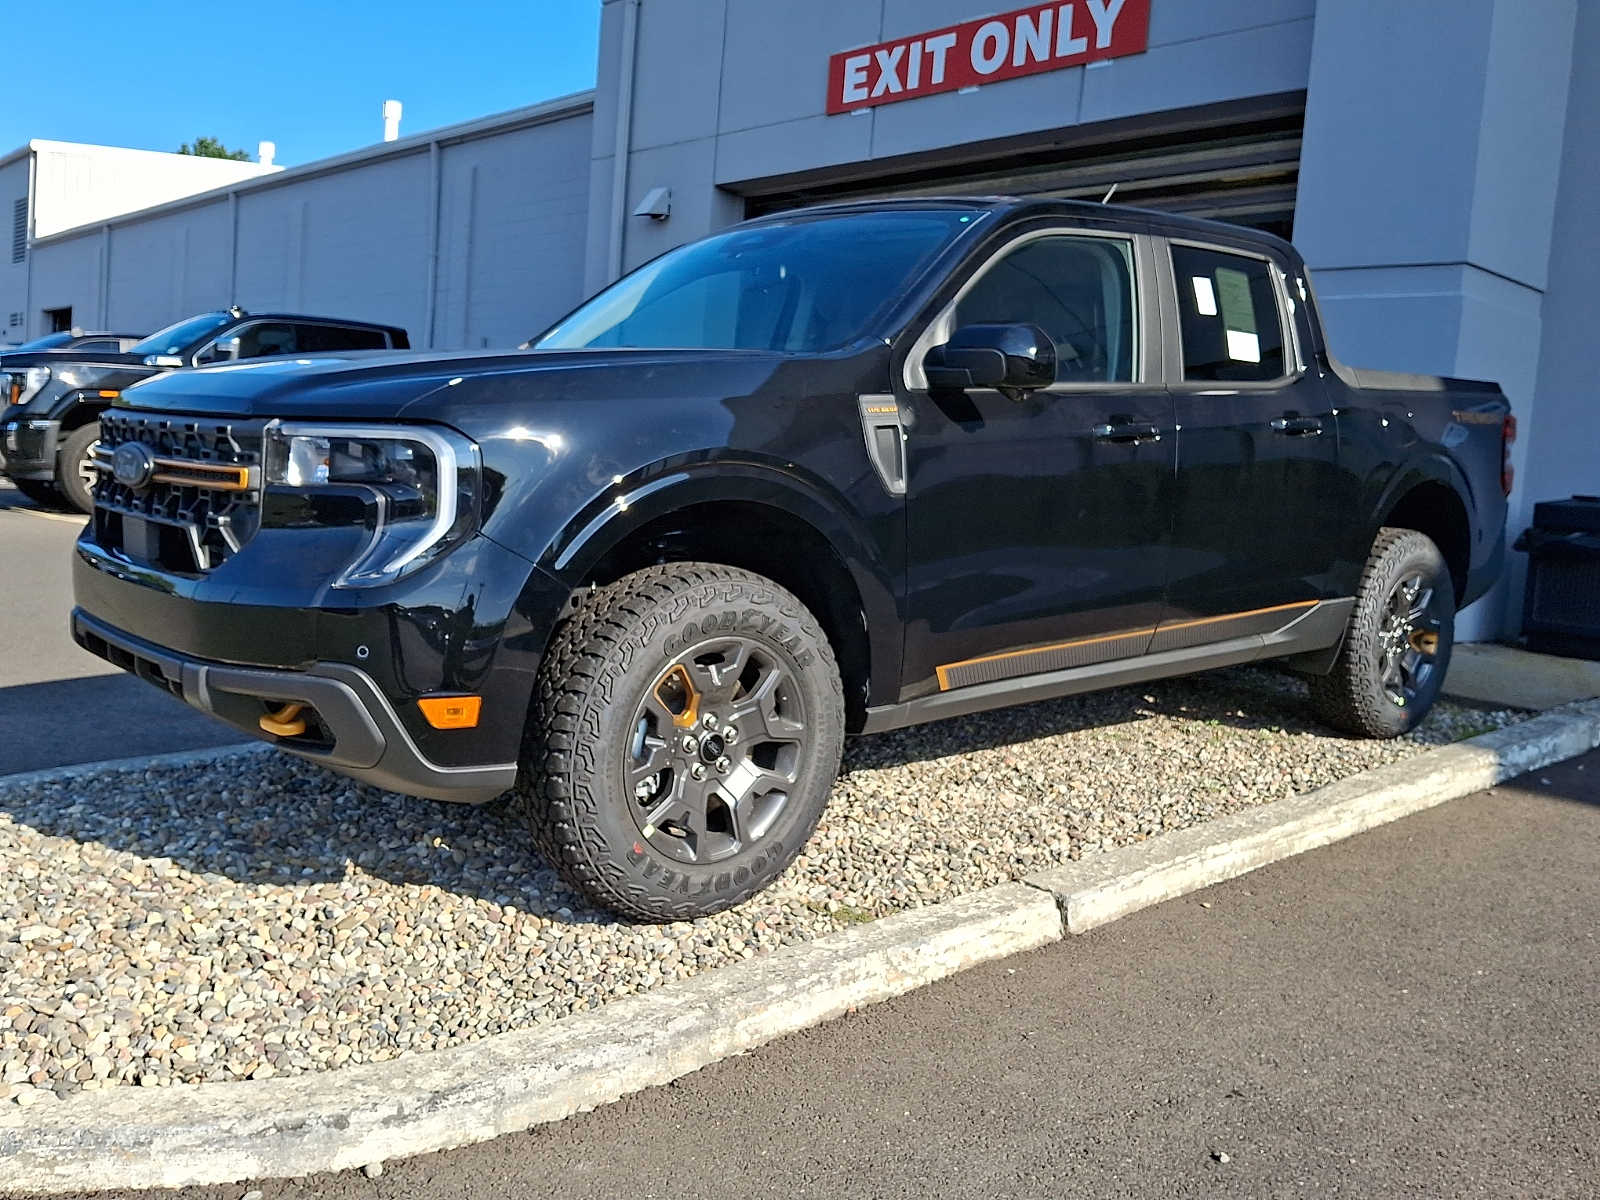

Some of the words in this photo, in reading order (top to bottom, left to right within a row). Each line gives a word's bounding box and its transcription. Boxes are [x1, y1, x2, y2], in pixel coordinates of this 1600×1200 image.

[842, 33, 957, 104] EXIT
[970, 0, 1126, 75] ONLY
[663, 608, 816, 670] GOODYEAR
